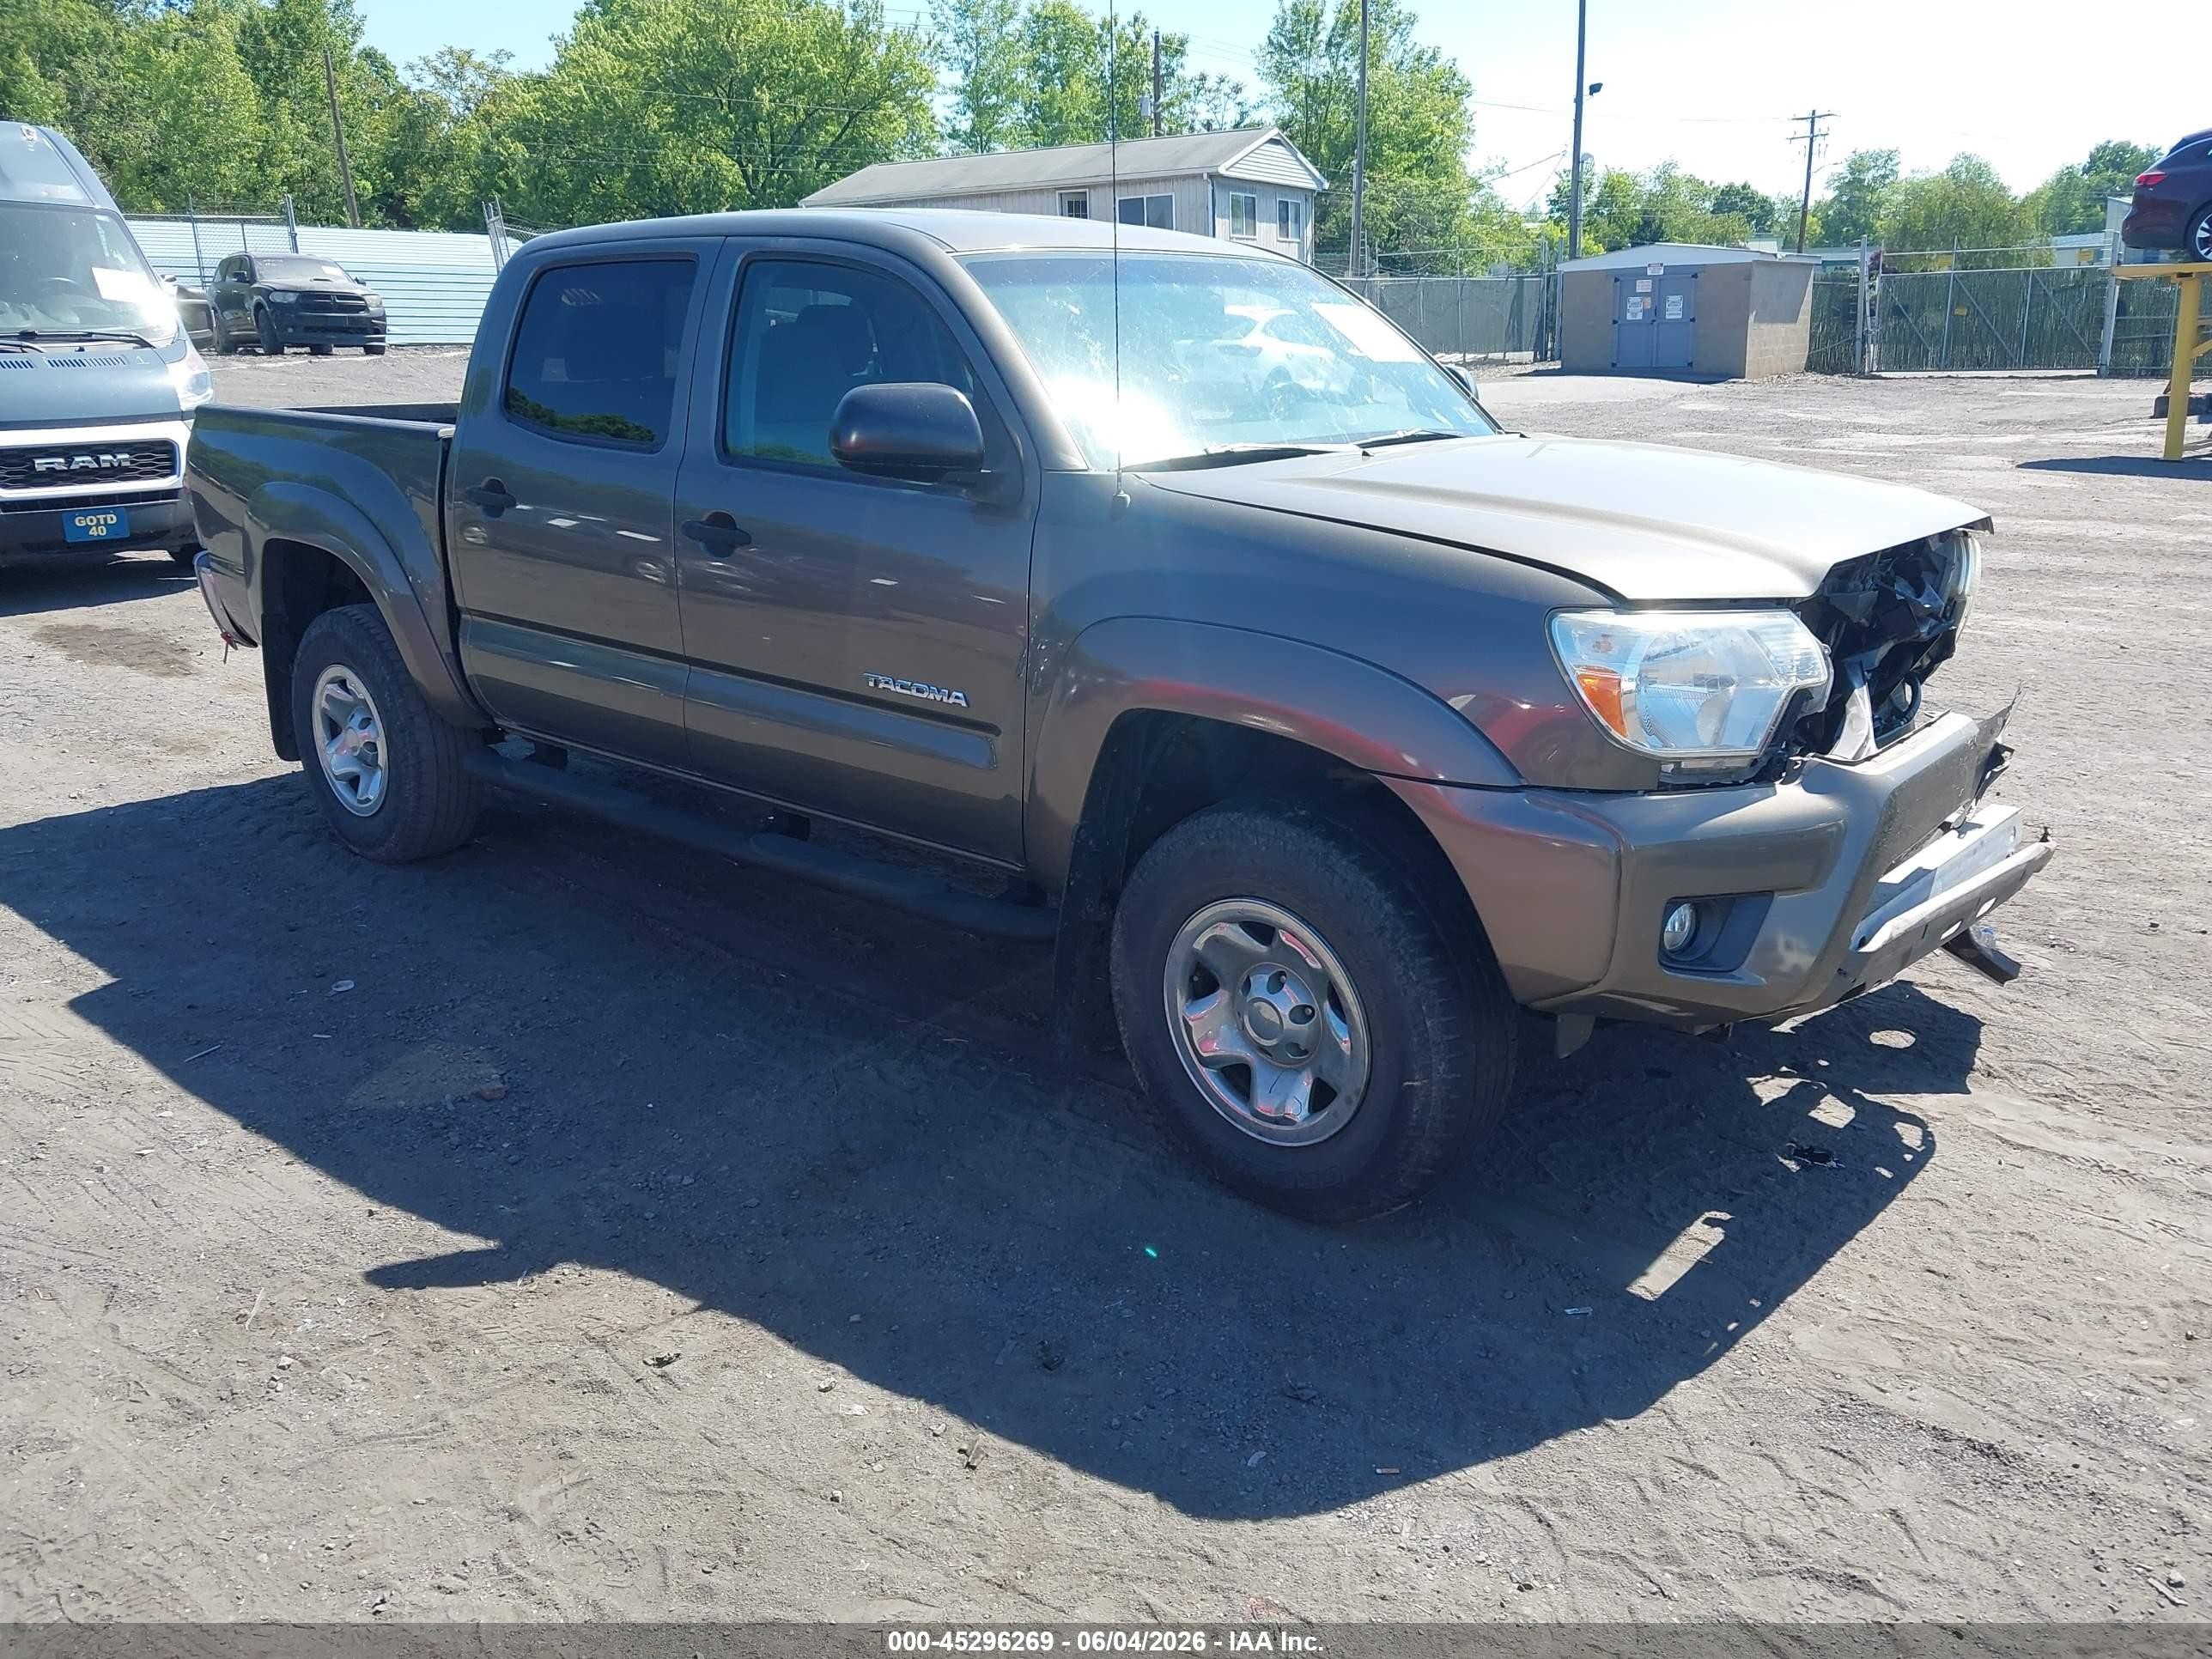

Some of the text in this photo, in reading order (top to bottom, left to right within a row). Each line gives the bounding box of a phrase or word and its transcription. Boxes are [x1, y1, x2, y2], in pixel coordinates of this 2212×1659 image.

[33, 453, 131, 471] RAM
[75, 514, 117, 526] GOTD
[88, 526, 107, 537] 40
[863, 672, 968, 708] TACOMA
